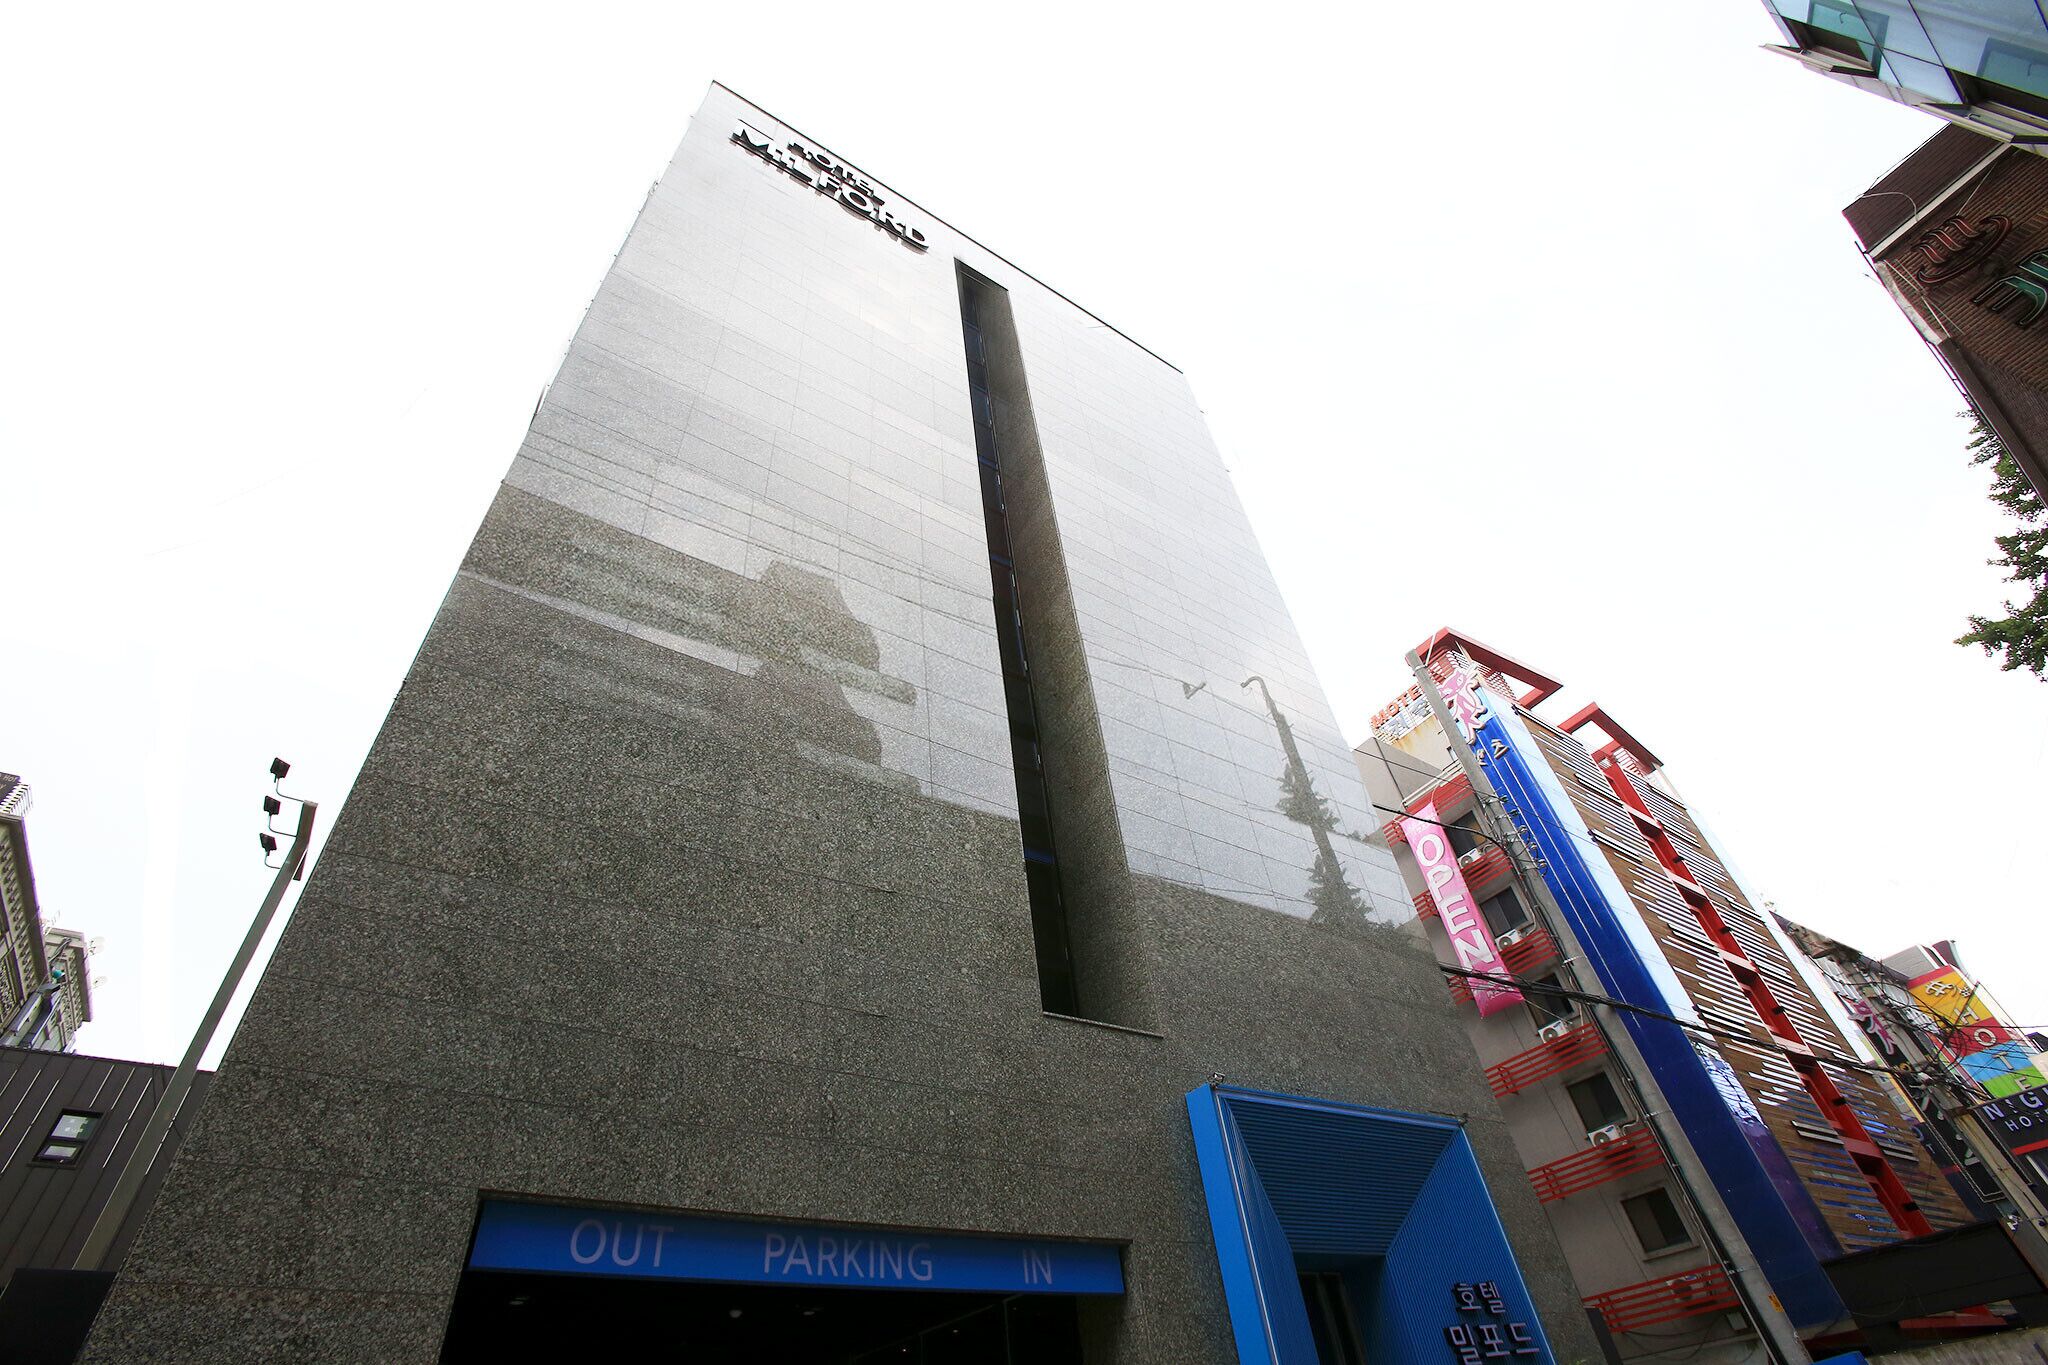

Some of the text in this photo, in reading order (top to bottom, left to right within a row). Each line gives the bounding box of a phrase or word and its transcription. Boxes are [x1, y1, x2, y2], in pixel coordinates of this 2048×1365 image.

[730, 119, 930, 252] MILFORD
[1416, 833, 1495, 971] OPEN
[569, 1218, 1053, 1285] OUT PARKING IN
[1457, 1281, 1506, 1314] 호텔
[1449, 1322, 1540, 1365] 밀포드
